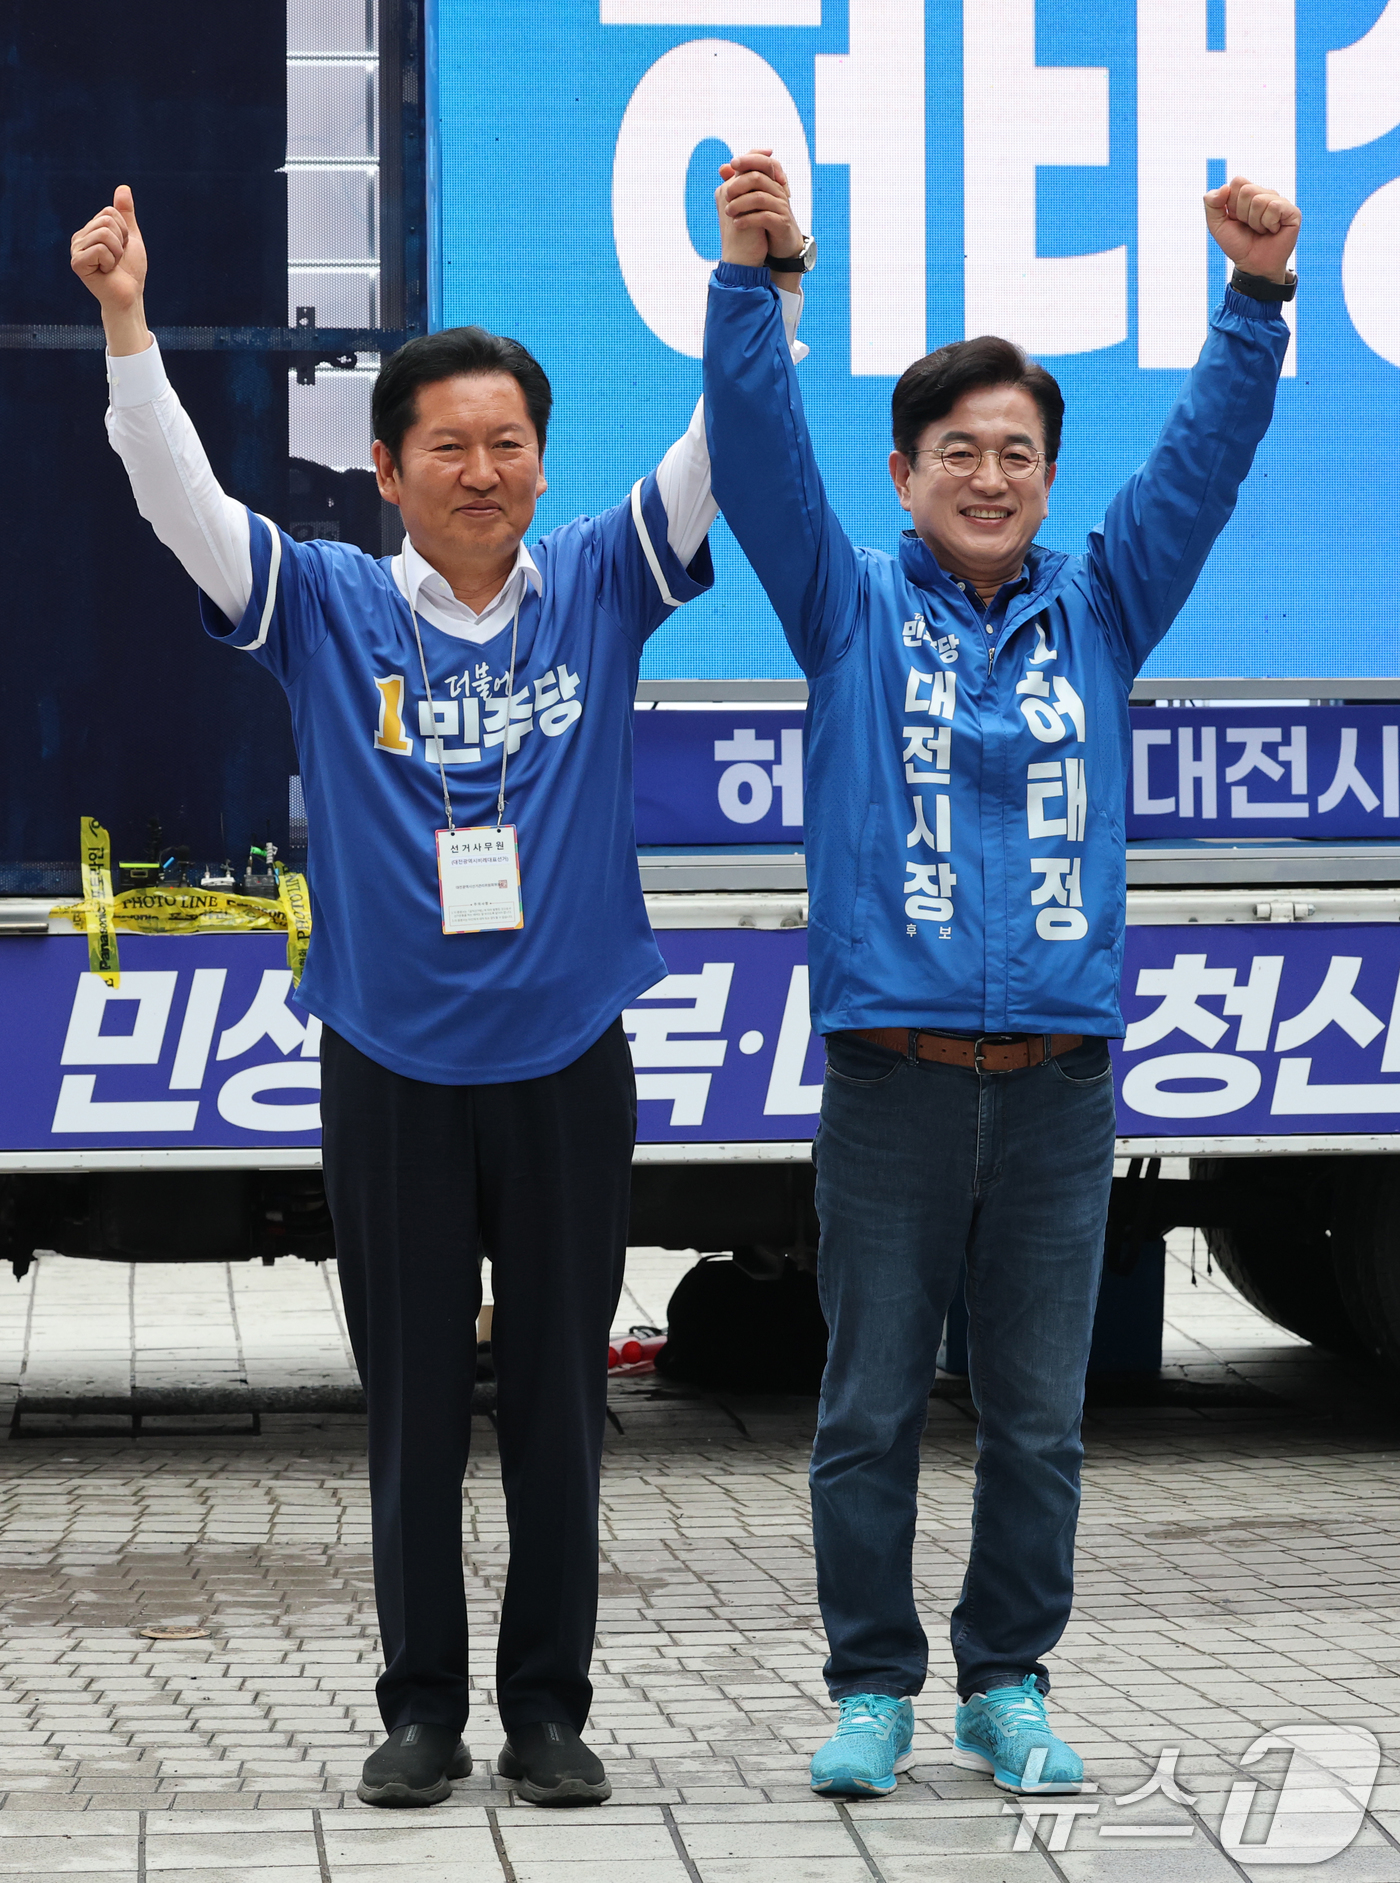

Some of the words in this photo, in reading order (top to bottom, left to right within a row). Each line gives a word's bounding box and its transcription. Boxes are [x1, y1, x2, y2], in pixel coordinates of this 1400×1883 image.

[902, 620, 960, 663] 민당
[374, 674, 413, 756] 1
[418, 664, 583, 764] 민주당
[903, 666, 957, 922] 대전시장
[1015, 671, 1089, 941] 허태정
[1132, 725, 1400, 819] 대전시
[450, 841, 505, 854] 선거사무원
[122, 895, 177, 909] PHOTO
[180, 896, 218, 909] LINE
[906, 923, 952, 940] 후보
